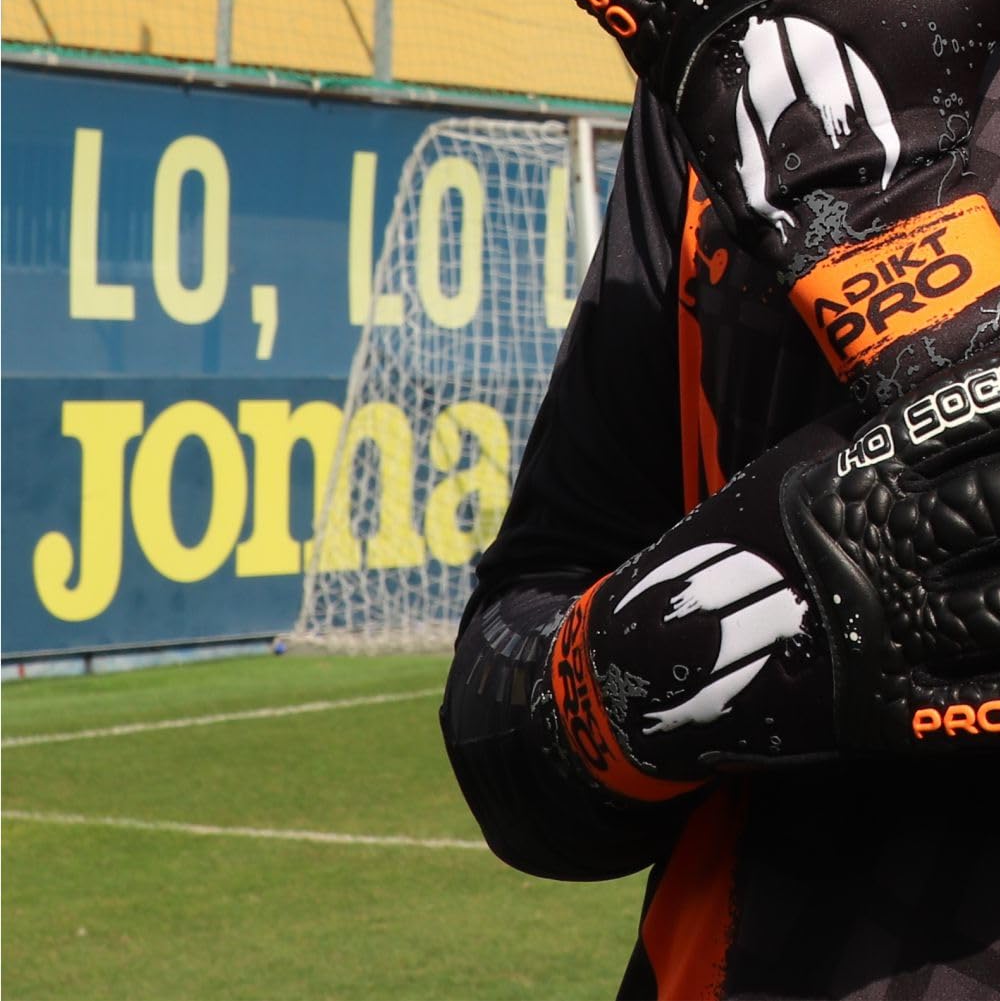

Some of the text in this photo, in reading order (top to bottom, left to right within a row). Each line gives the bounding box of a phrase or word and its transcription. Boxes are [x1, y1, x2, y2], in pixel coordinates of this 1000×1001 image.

[69, 127, 279, 360] LO,
[348, 151, 485, 329] LO
[814, 227, 948, 328] ADIKT
[825, 254, 973, 361] PRO
[836, 423, 895, 477] HO
